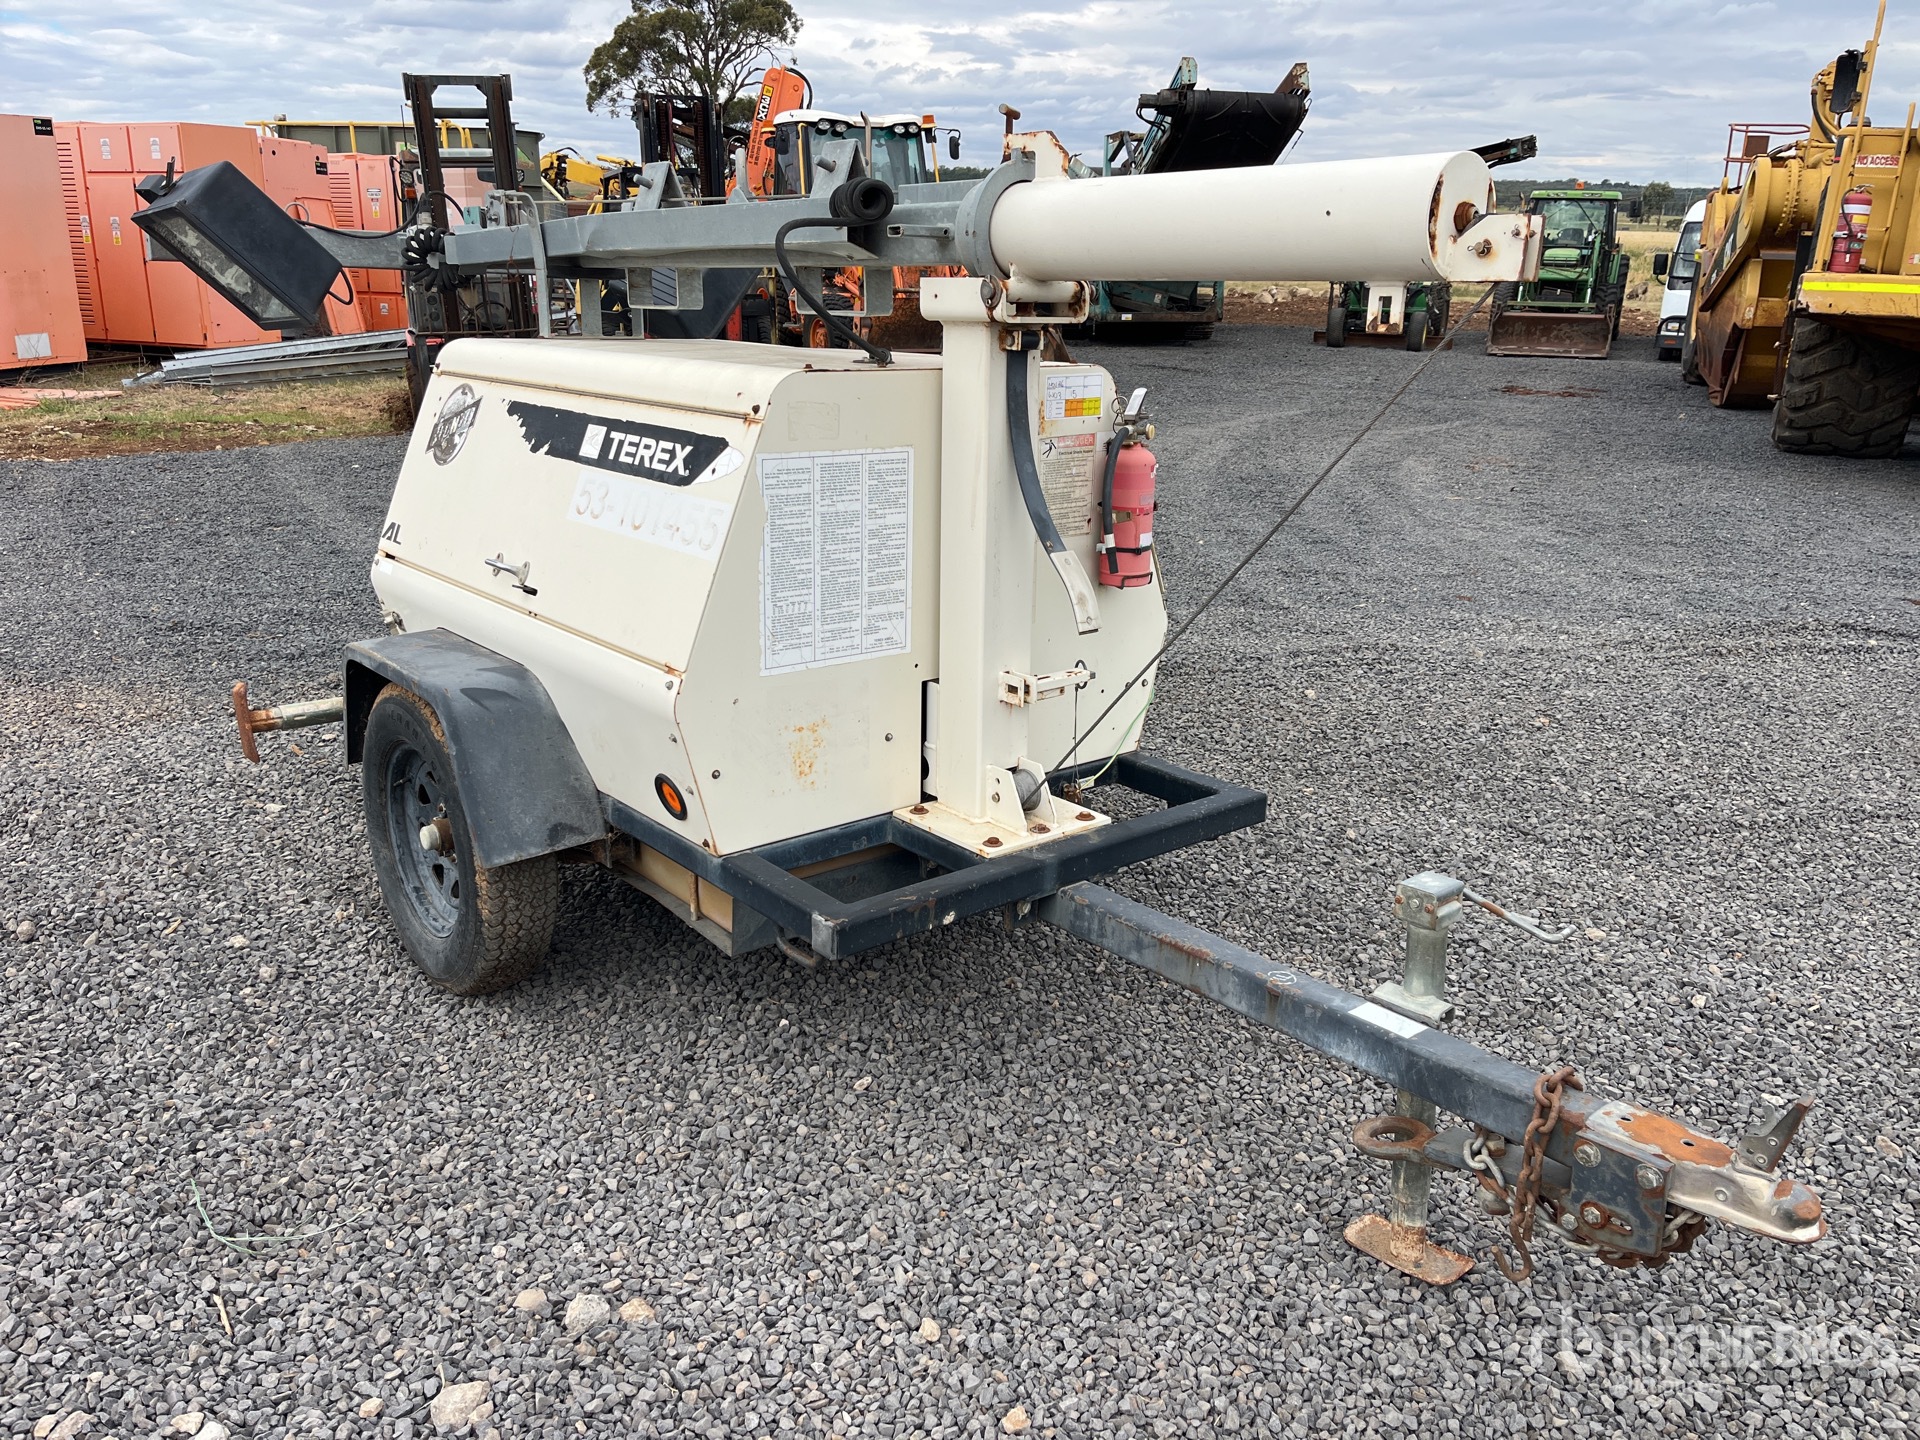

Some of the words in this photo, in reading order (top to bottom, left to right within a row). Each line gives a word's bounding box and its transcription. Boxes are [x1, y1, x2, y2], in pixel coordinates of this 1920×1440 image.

[757, 96, 770, 120] 3CX
[1857, 155, 1869, 166] NO
[1869, 155, 1900, 166] ACCESS
[608, 431, 693, 476] TEREX
